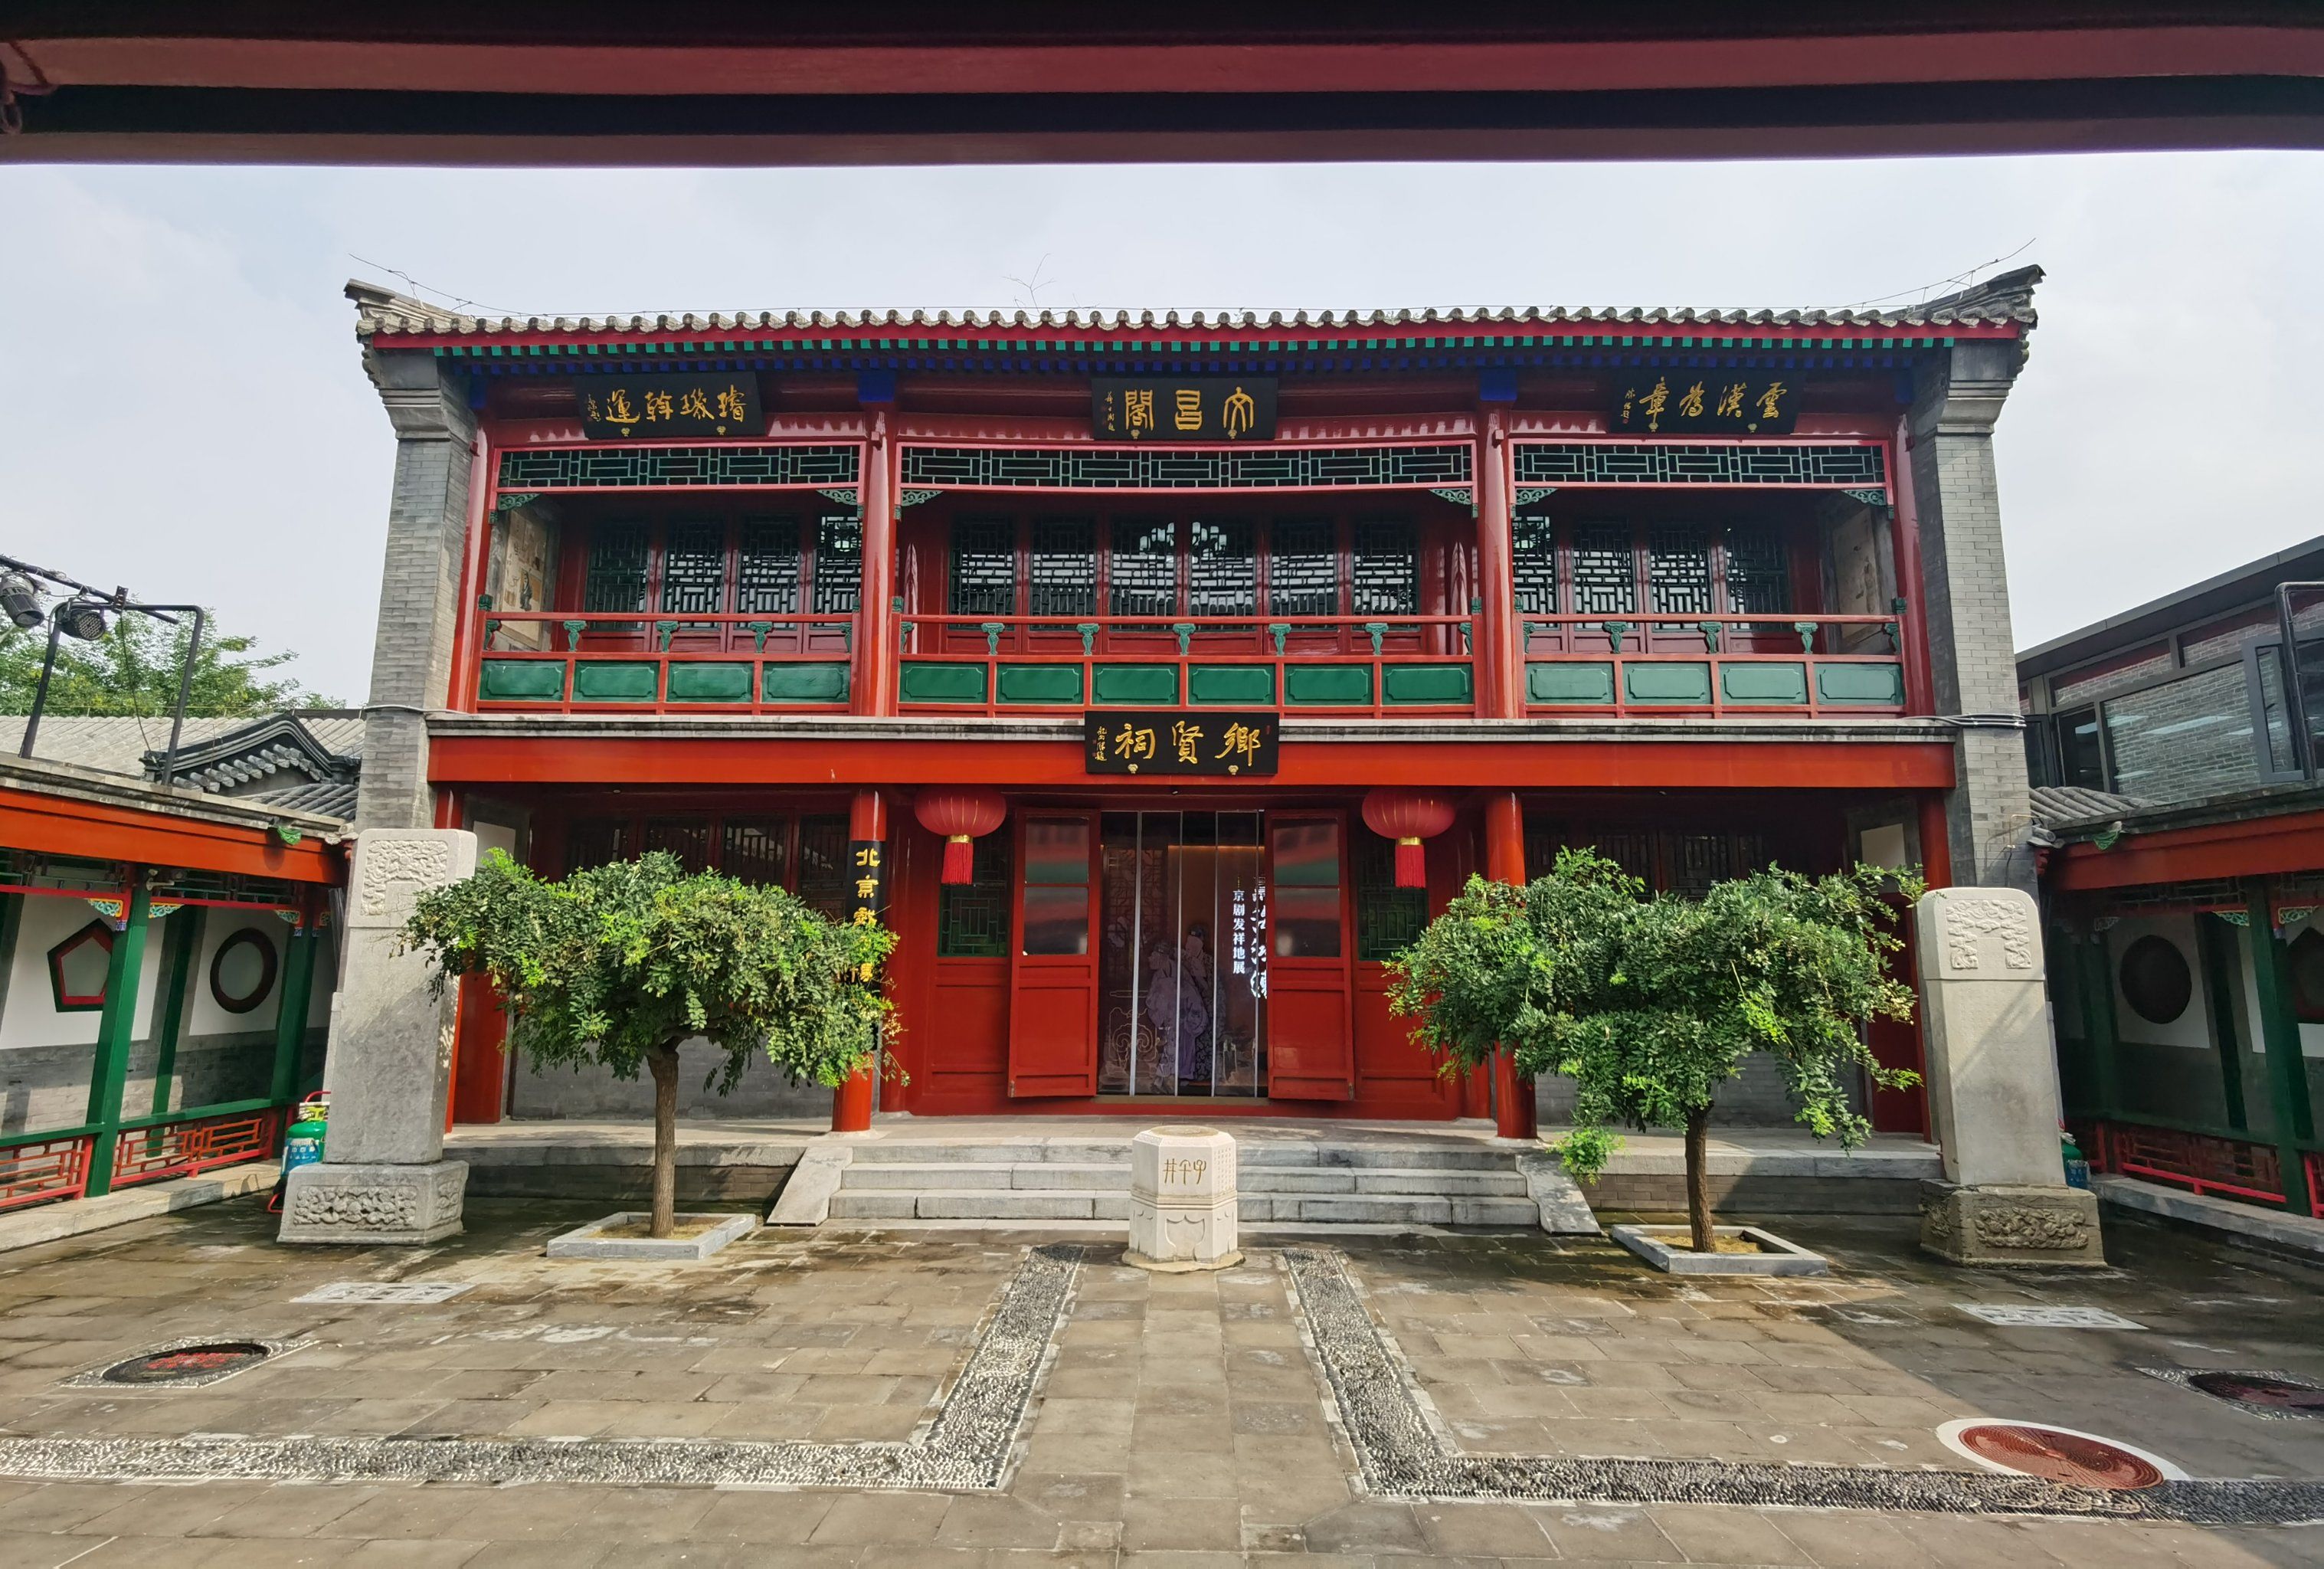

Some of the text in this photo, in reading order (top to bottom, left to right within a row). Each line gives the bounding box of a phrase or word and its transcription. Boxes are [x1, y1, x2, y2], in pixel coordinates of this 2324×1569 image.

[1125, 386, 1254, 432] 文昌閣
[1115, 720, 1262, 766] 鄉賢祠
[1232, 889, 1245, 974] 京剧发祥地展
